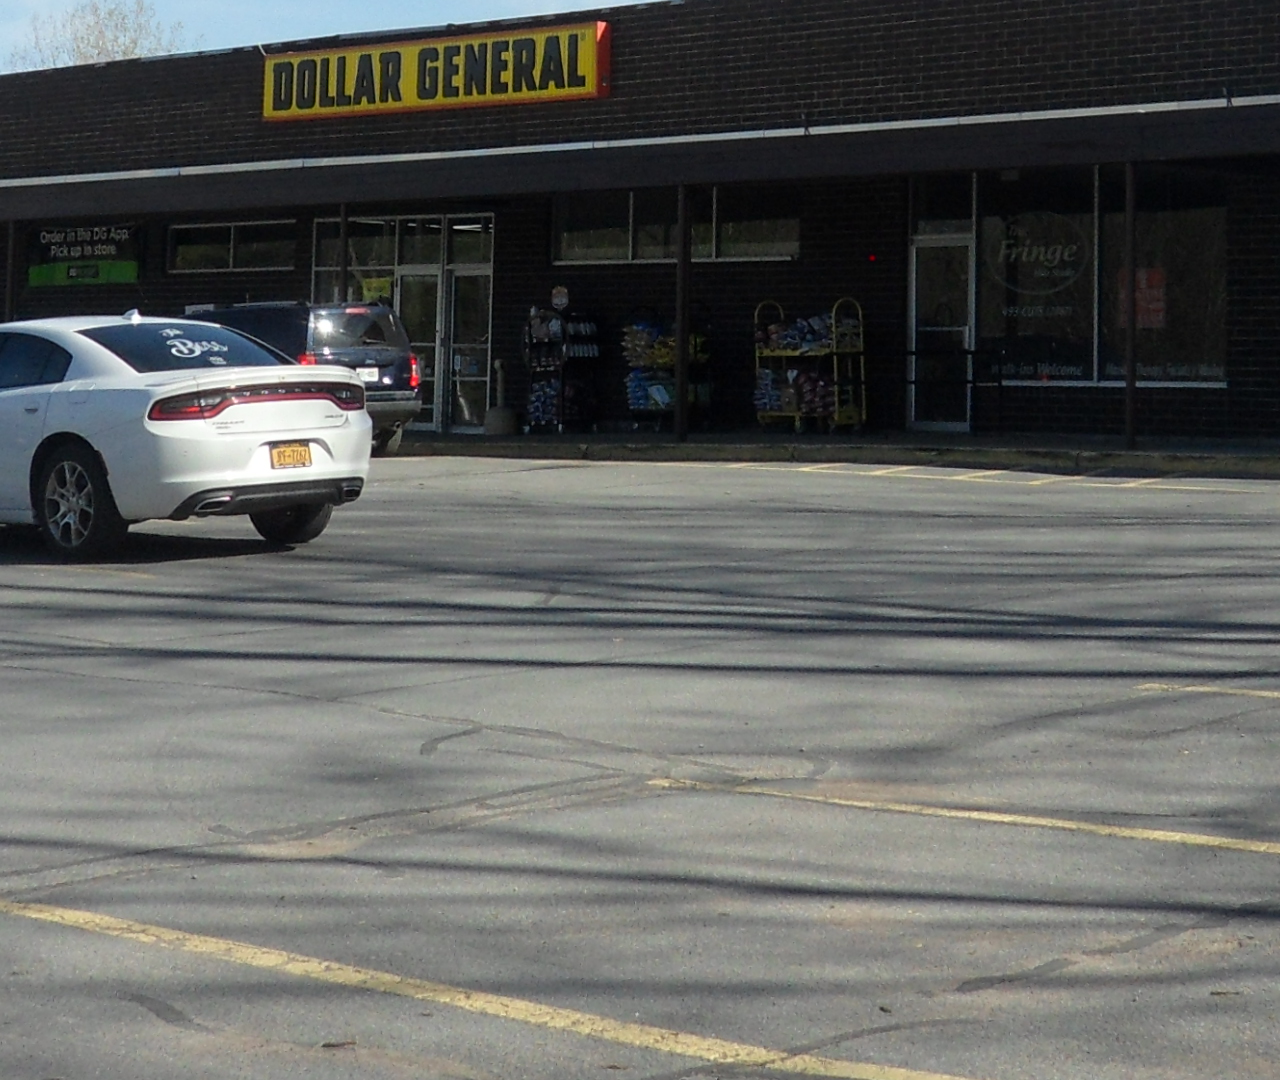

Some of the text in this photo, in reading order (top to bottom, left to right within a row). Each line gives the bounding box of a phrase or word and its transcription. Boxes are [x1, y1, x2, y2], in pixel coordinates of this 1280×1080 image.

[272, 33, 587, 111] DOLLAR GENERAL
[40, 231, 65, 243] Order
[67, 228, 75, 242] in
[77, 228, 91, 241] the
[93, 227, 107, 240] DG
[50, 243, 117, 258] Pick up in store
[998, 239, 1078, 267] Fringe
[1037, 362, 1083, 376] Welcome
